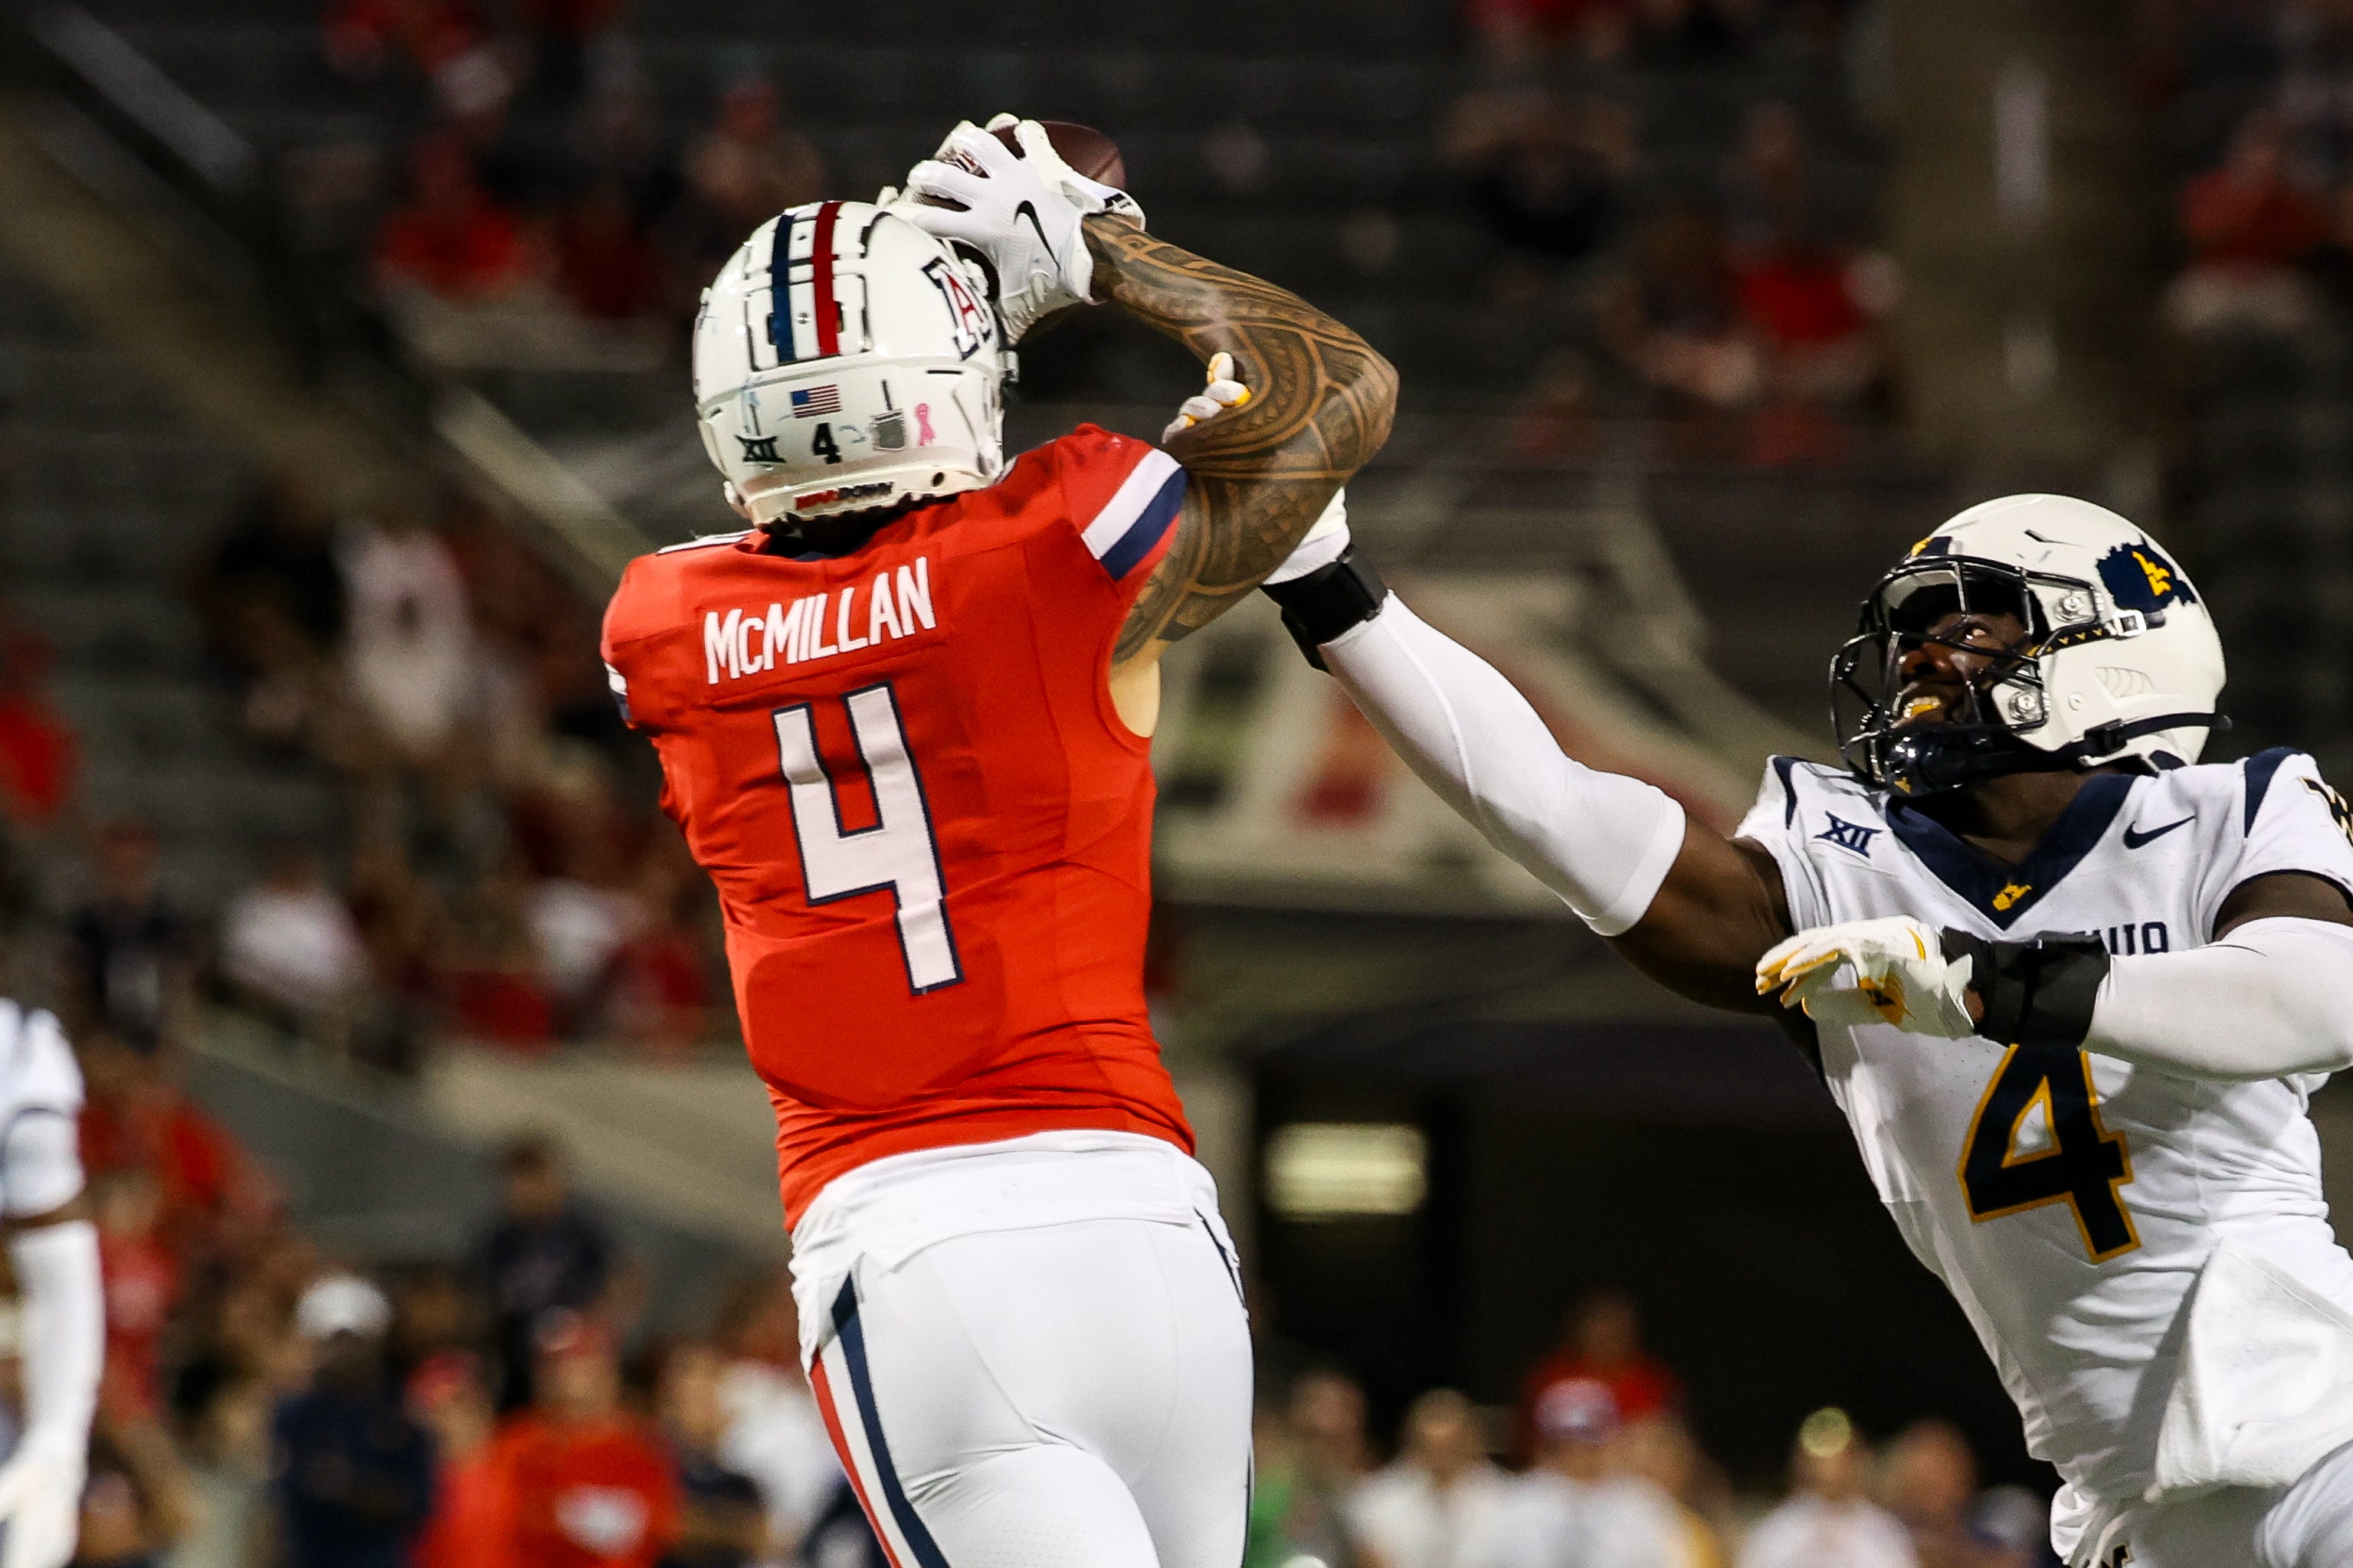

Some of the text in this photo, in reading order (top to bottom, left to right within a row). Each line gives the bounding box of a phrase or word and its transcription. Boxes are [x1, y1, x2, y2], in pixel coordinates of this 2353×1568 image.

[812, 423, 842, 464] 4
[771, 680, 965, 997] 4
[1956, 1043, 2142, 1265] 4
